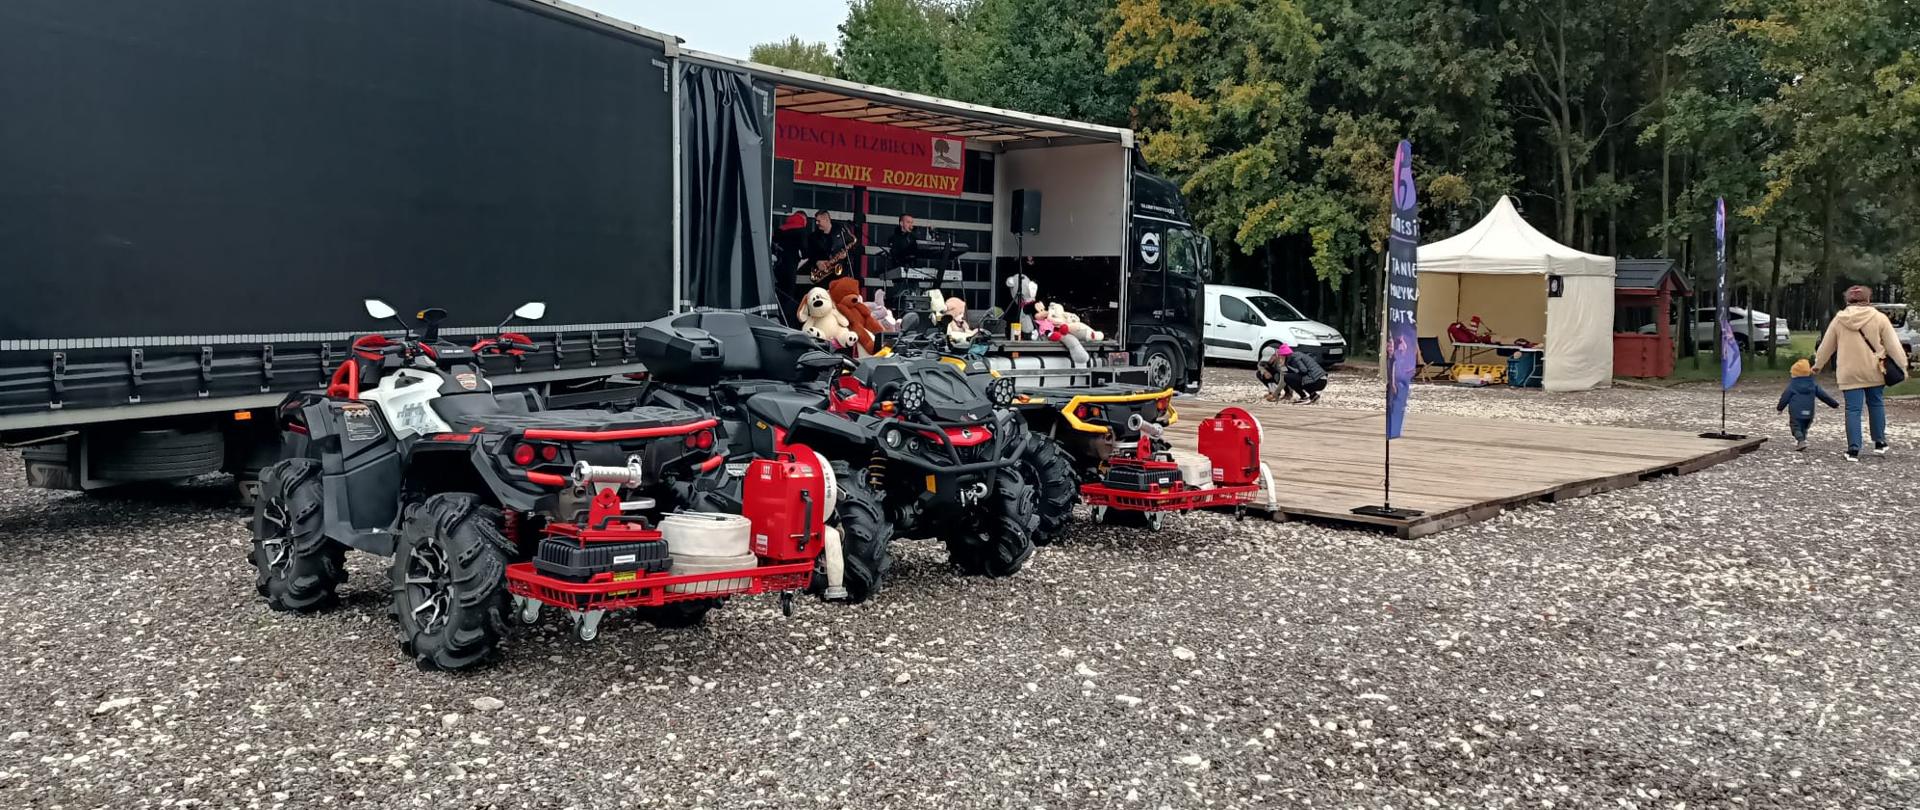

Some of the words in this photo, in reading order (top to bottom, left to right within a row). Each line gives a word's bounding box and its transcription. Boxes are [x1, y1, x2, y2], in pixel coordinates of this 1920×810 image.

[778, 123, 847, 148] YDENCJA
[813, 160, 873, 182] PIKNIK
[882, 169, 960, 192] RODZINNY
